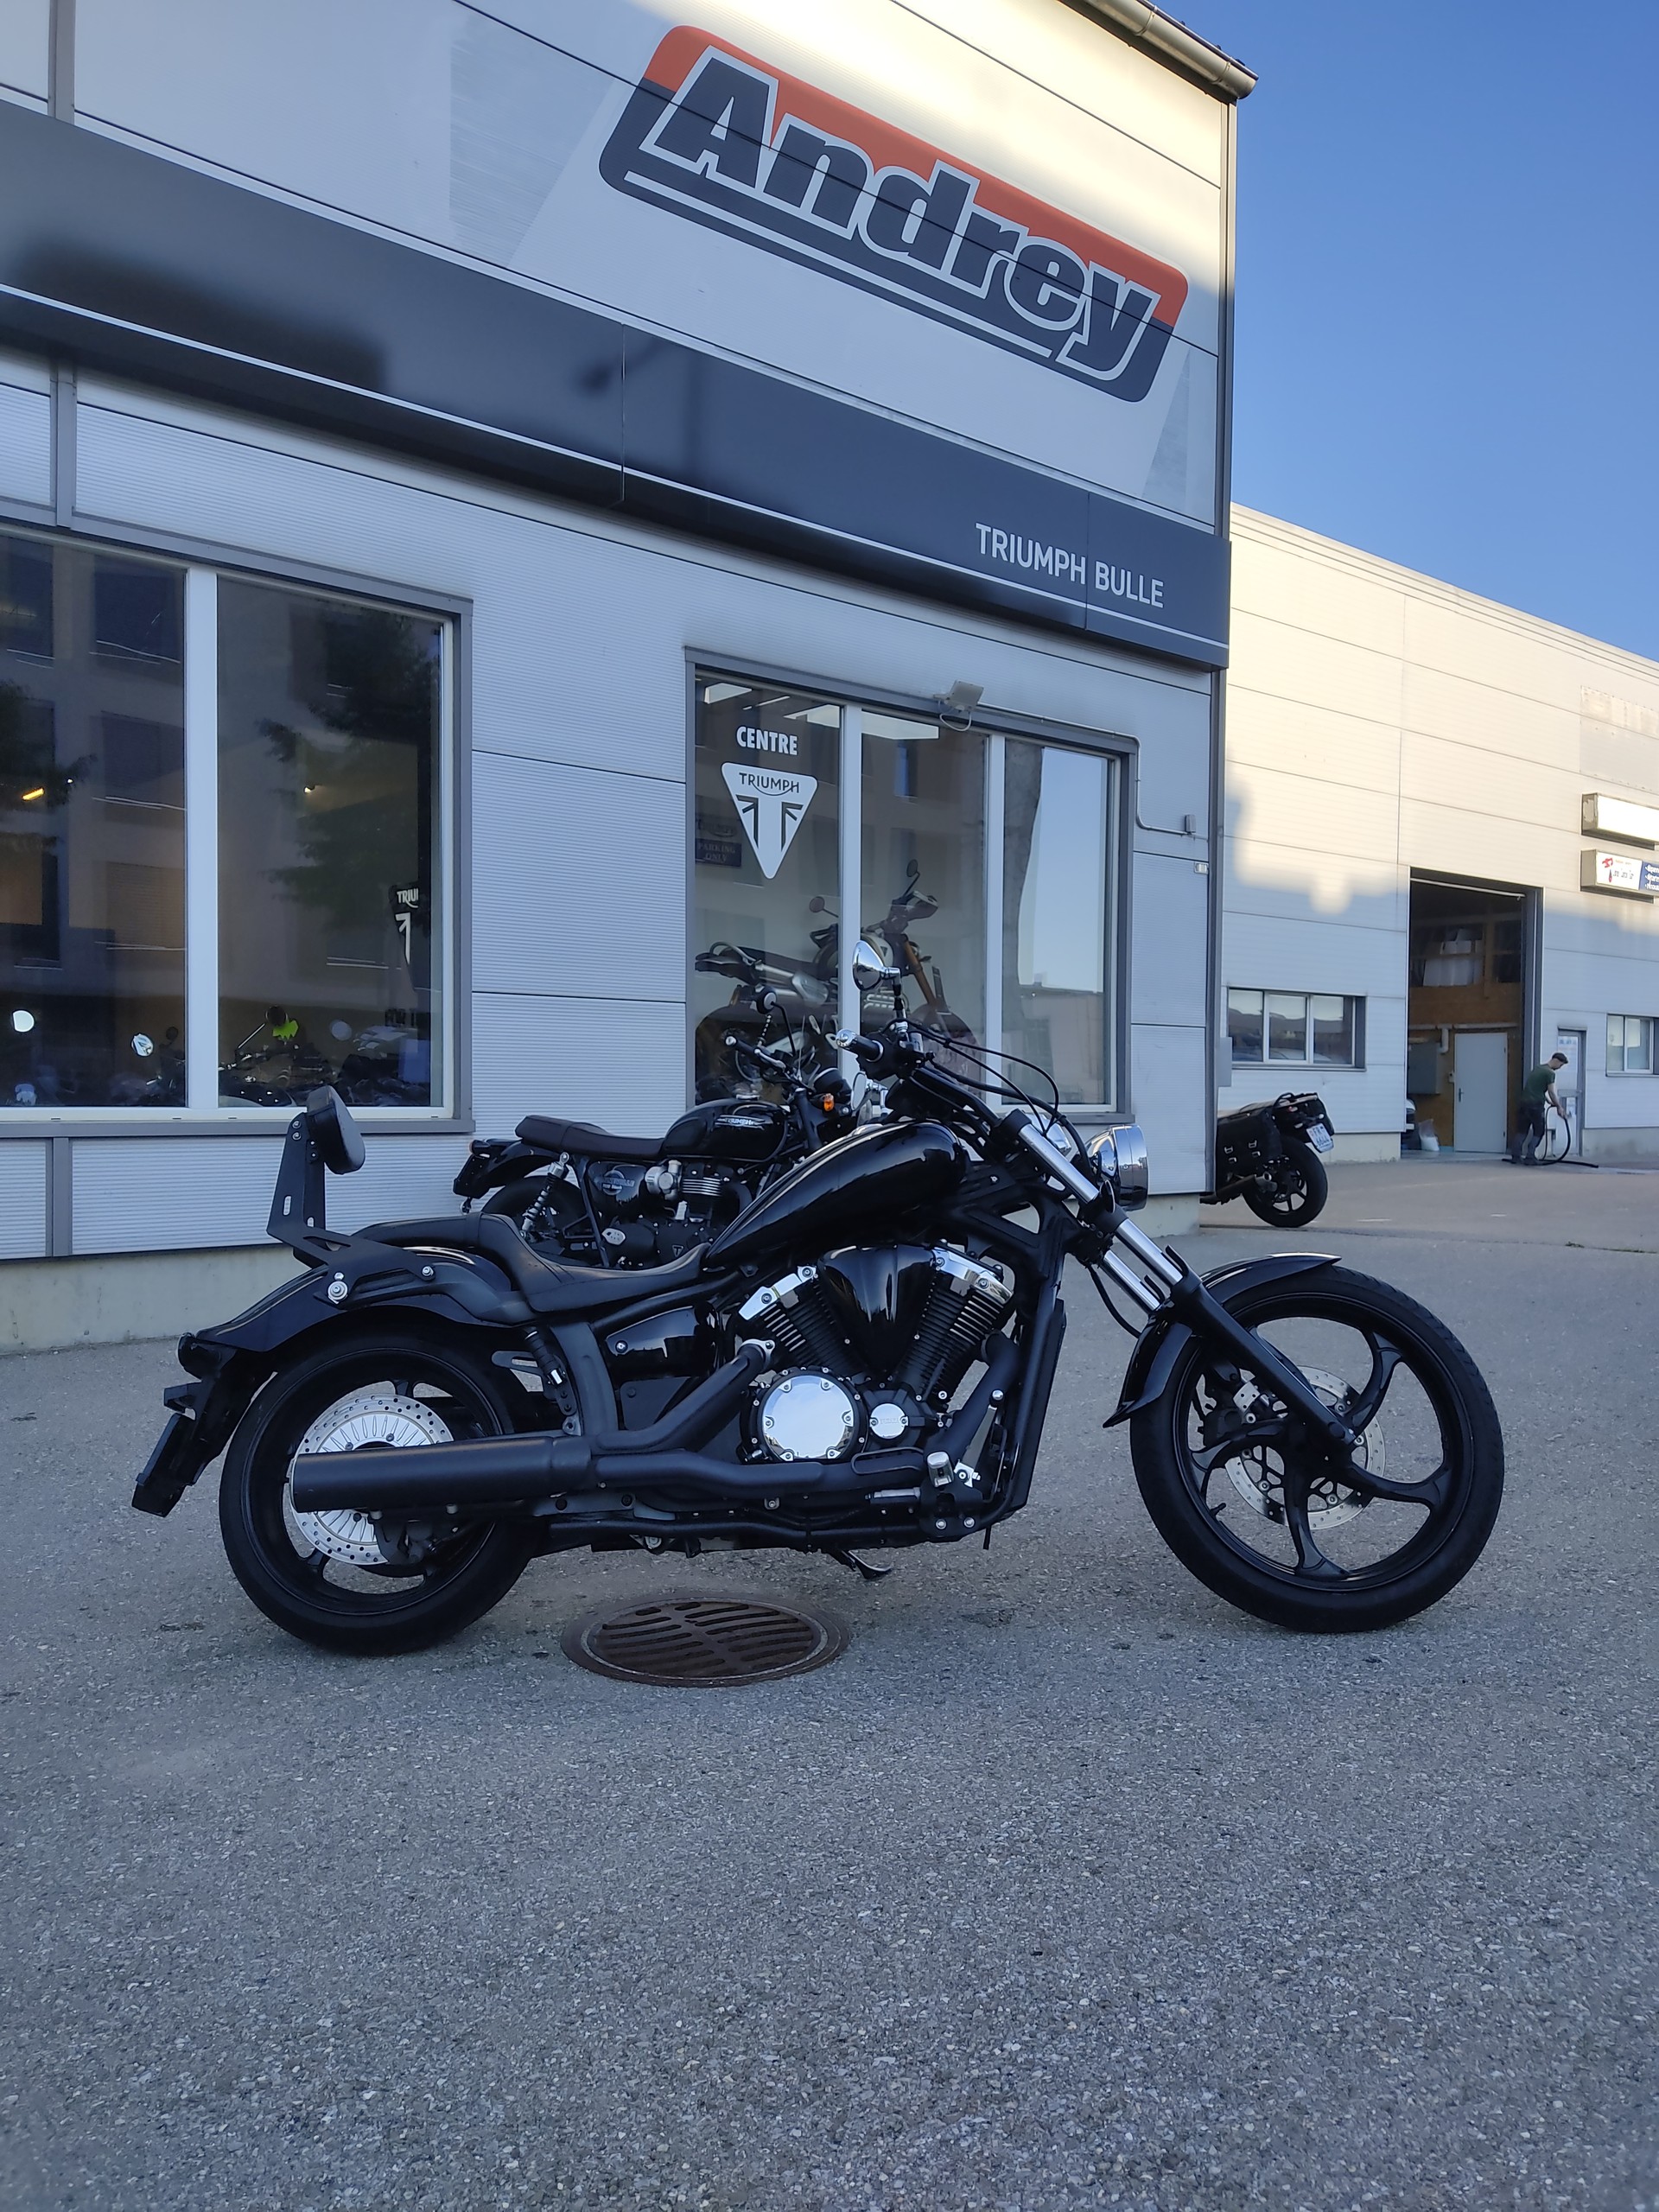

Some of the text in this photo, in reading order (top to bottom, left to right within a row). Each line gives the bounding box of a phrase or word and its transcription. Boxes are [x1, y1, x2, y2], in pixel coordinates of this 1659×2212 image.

[639, 45, 1160, 380] Andrey
[976, 523, 1164, 608] TRIUMPH BULLE
[736, 726, 798, 756] CENTRE
[739, 772, 800, 796] TRIUMPH
[698, 842, 735, 854] PARKING
[705, 853, 728, 863] ONLY
